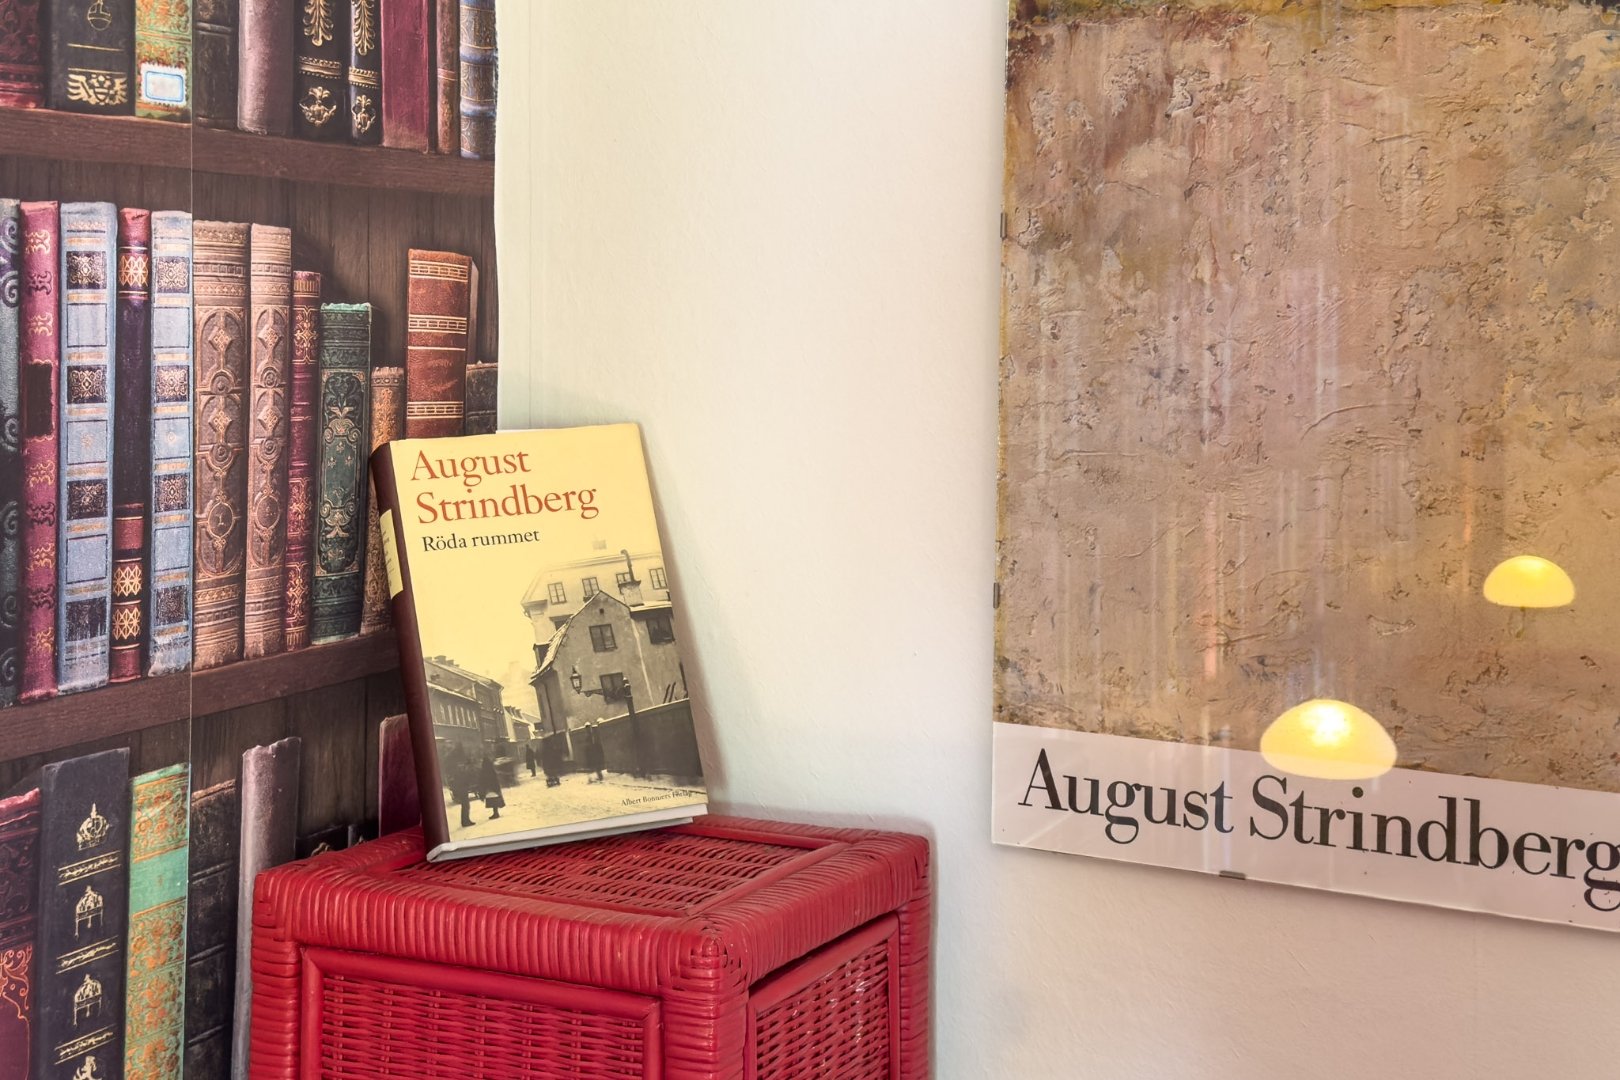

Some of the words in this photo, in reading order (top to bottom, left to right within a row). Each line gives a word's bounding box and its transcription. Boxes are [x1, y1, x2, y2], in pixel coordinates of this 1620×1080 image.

[410, 450, 532, 487] August
[416, 484, 600, 524] Strindberg
[422, 533, 467, 552] Röda
[472, 530, 540, 547] rummet
[621, 798, 642, 806] Albert
[1018, 748, 1234, 844] August
[1249, 774, 1620, 912] Strindberg
